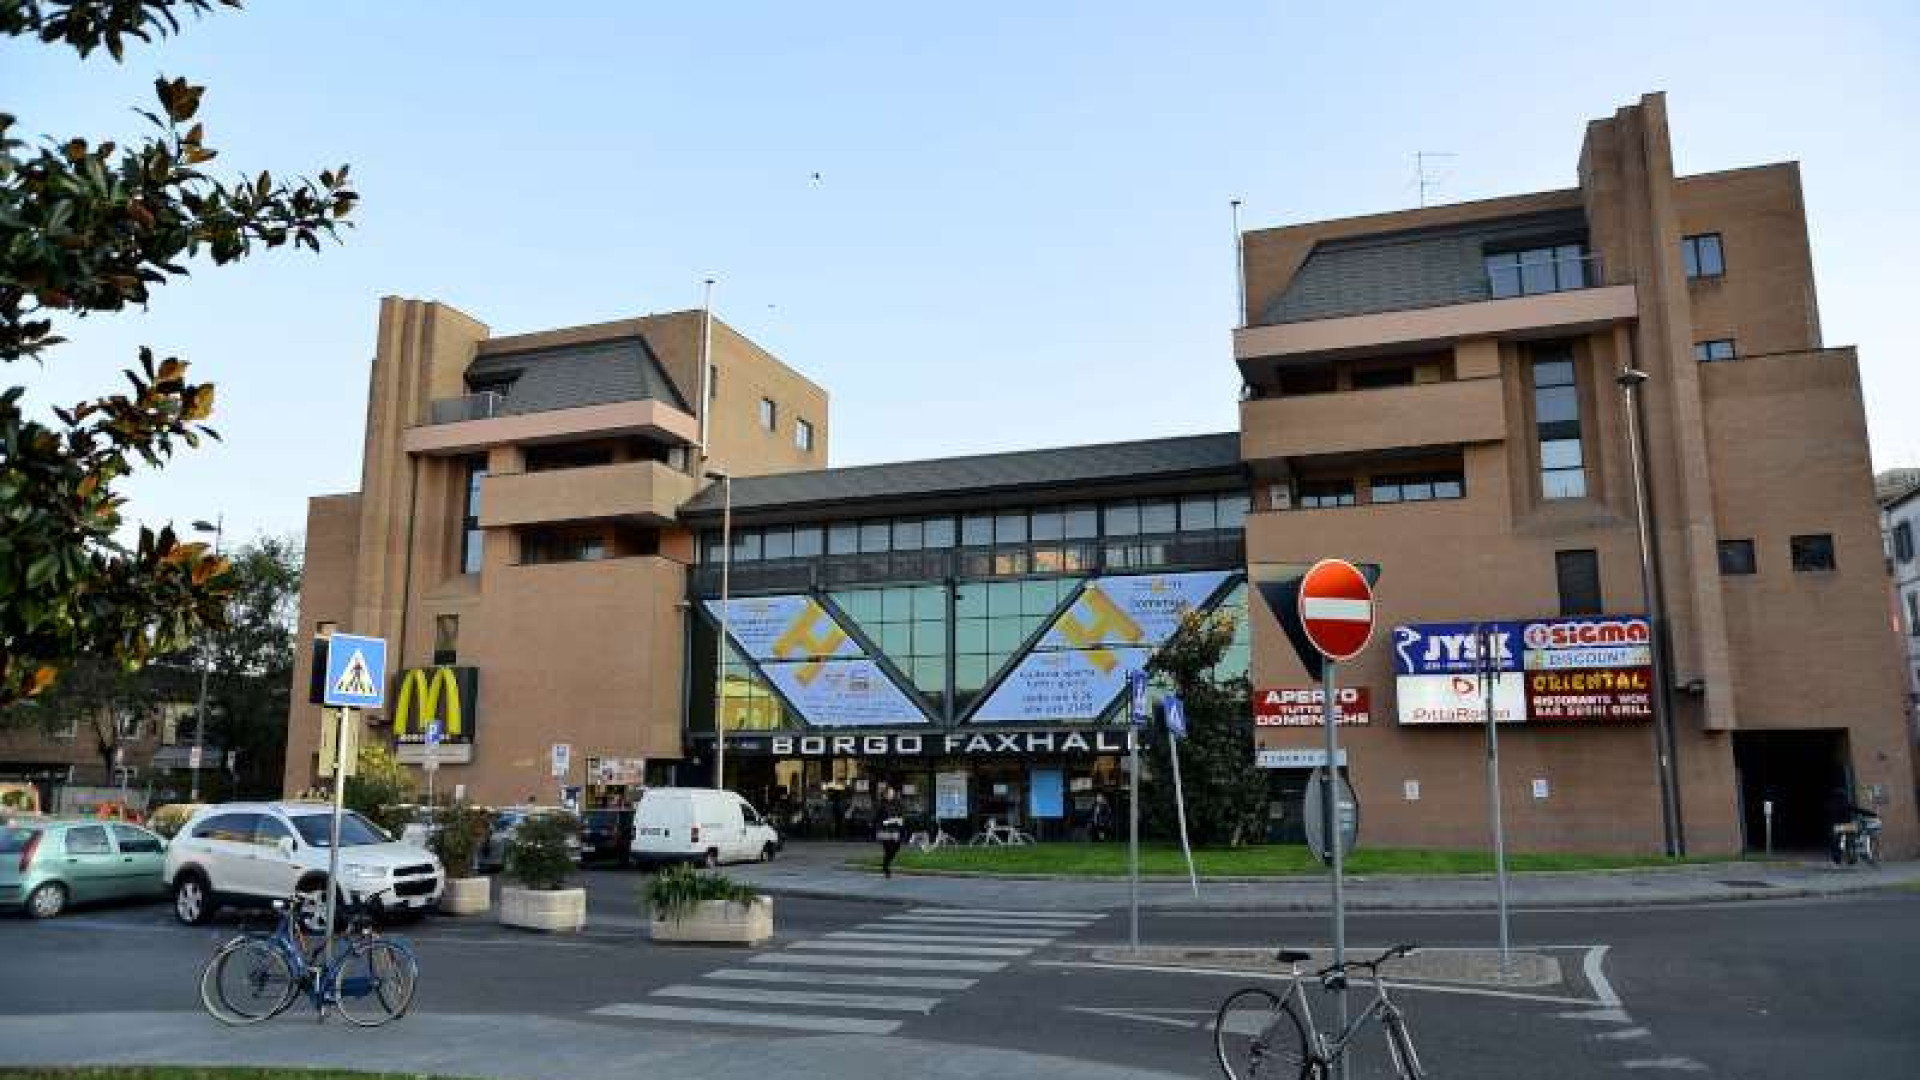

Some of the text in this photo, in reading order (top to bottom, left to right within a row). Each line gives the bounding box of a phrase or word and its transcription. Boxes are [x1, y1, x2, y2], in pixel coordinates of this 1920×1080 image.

[1423, 632, 1513, 661] JYSK
[1534, 672, 1646, 692] ORIENTAL
[1257, 712, 1369, 726] DOMENCHE
[1413, 707, 1511, 721] PittaRoo
[771, 731, 1148, 755] BORGO FAXHALL
